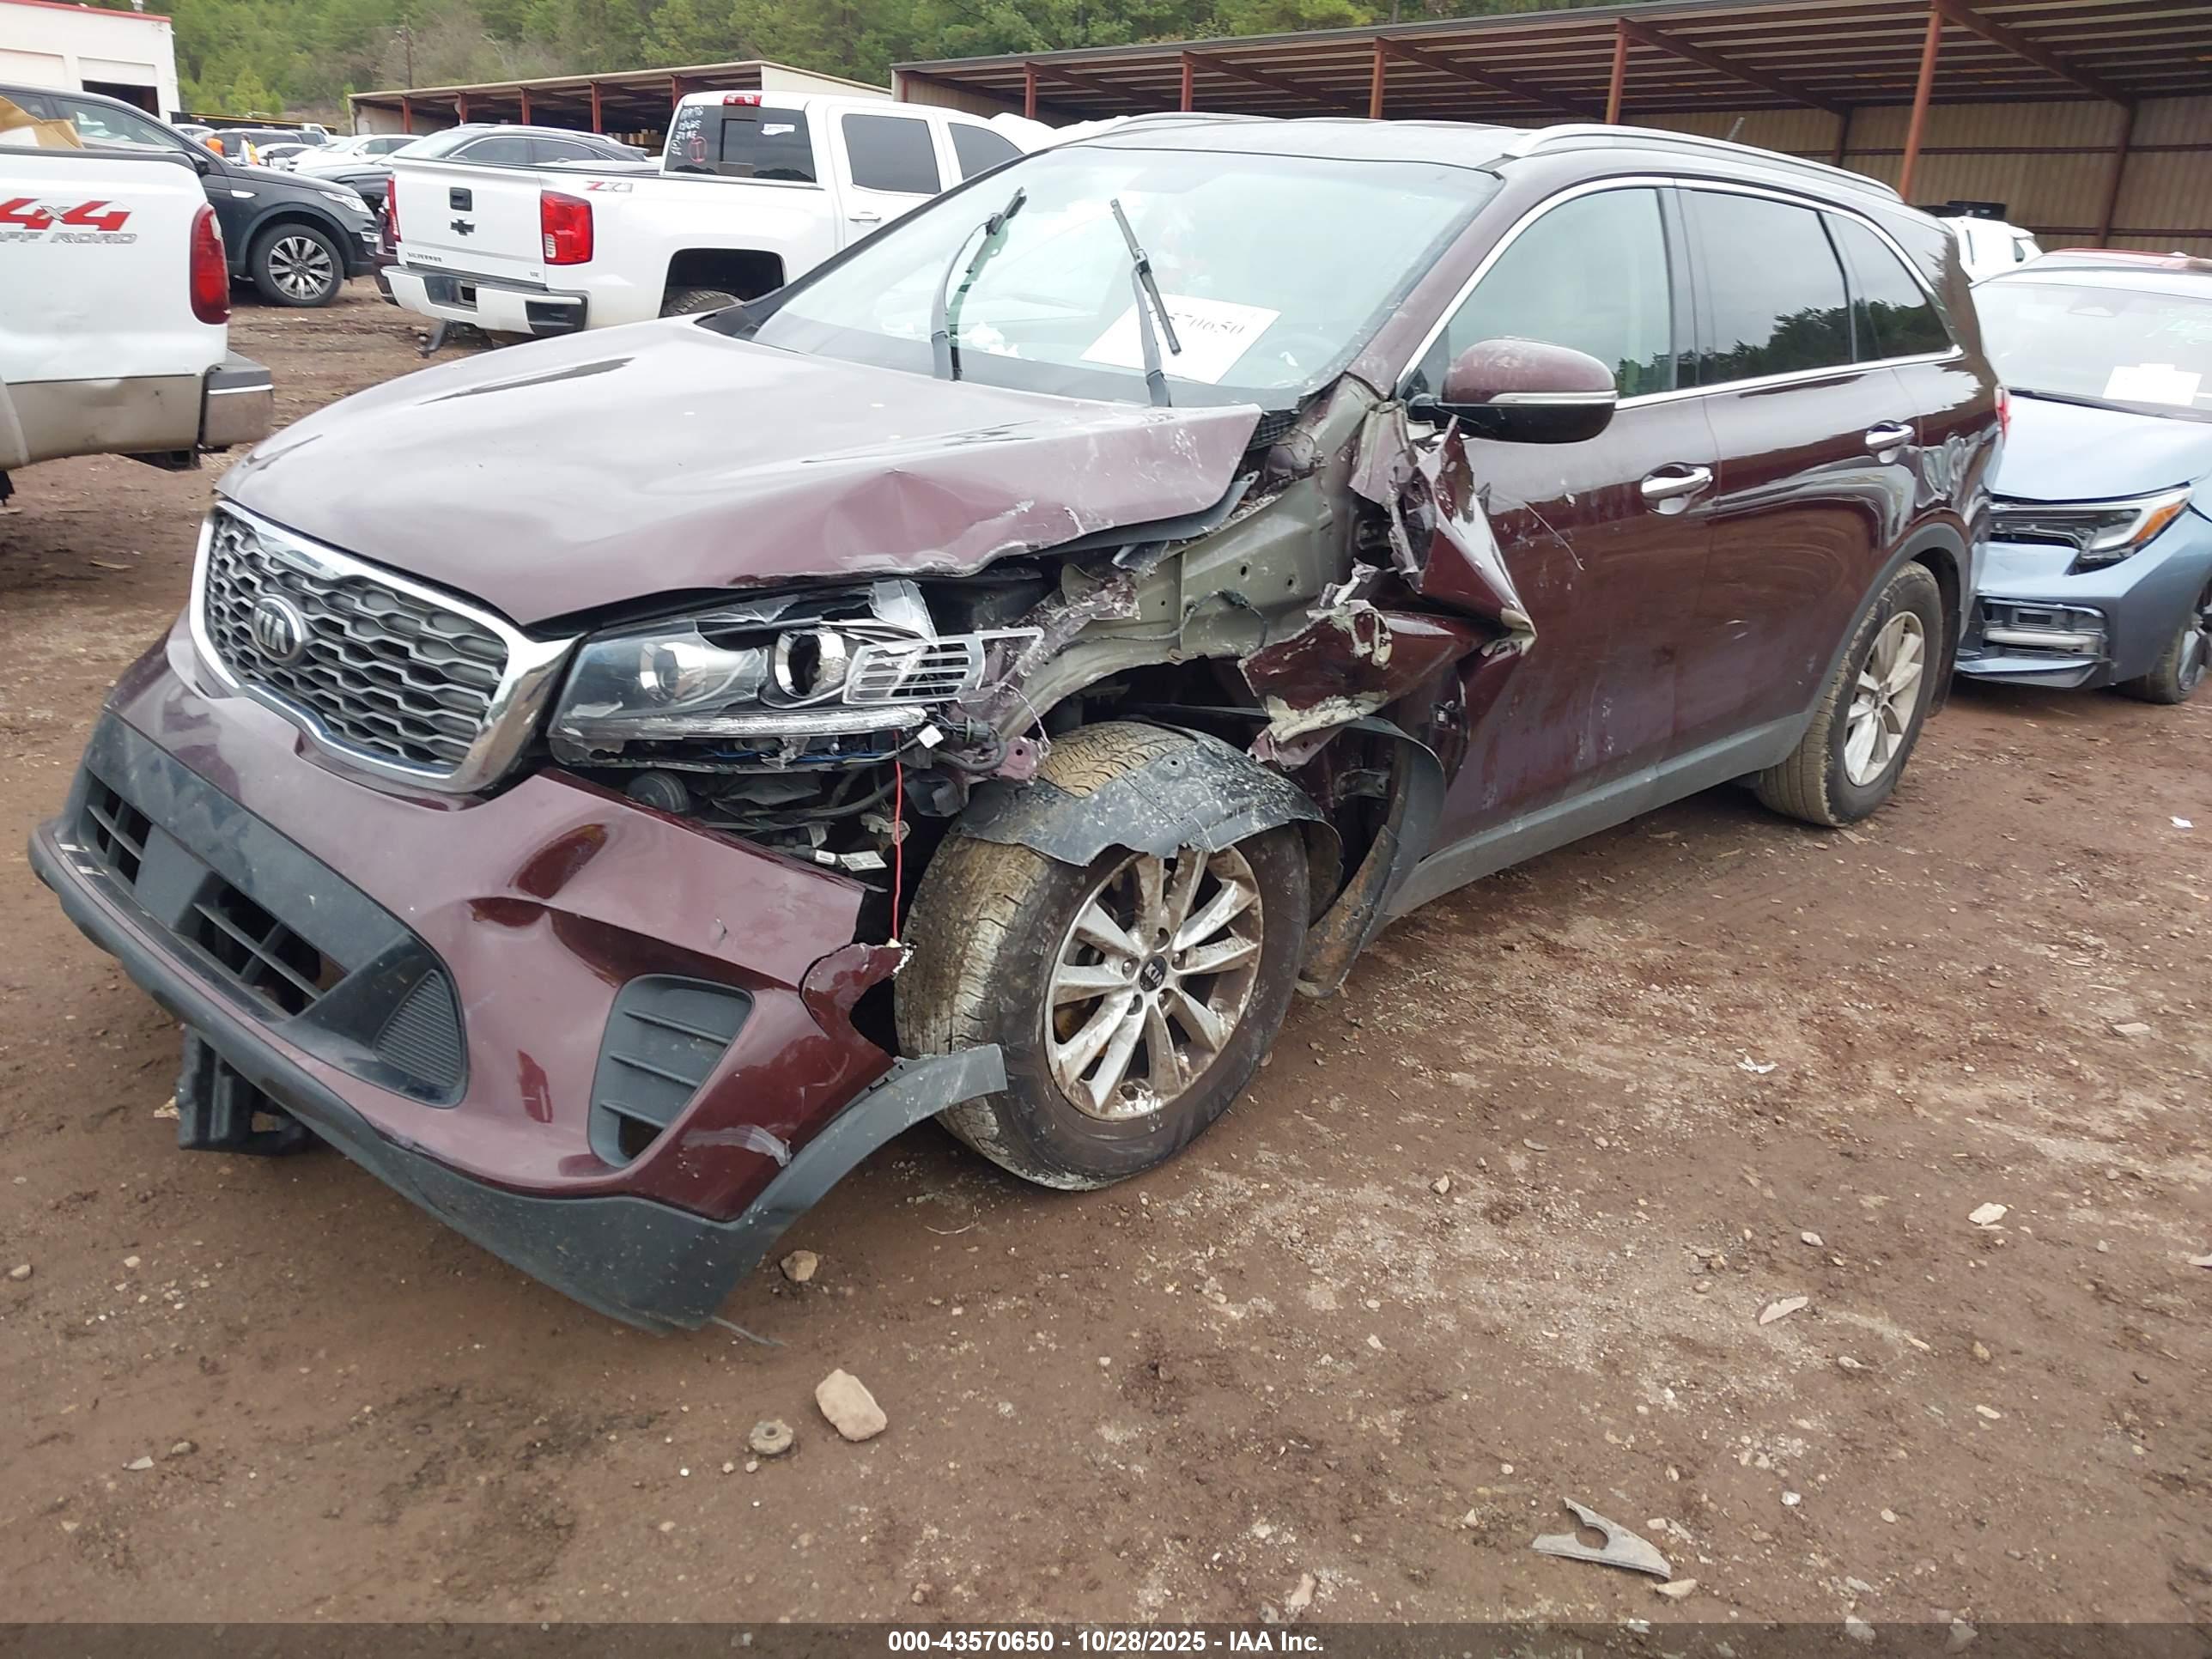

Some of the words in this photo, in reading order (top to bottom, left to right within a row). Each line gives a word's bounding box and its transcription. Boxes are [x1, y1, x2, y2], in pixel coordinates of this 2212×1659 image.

[0, 231, 43, 243] FF
[50, 232, 137, 244] ROAD
[253, 606, 289, 654] KIA
[1145, 962, 1163, 987] KIA
